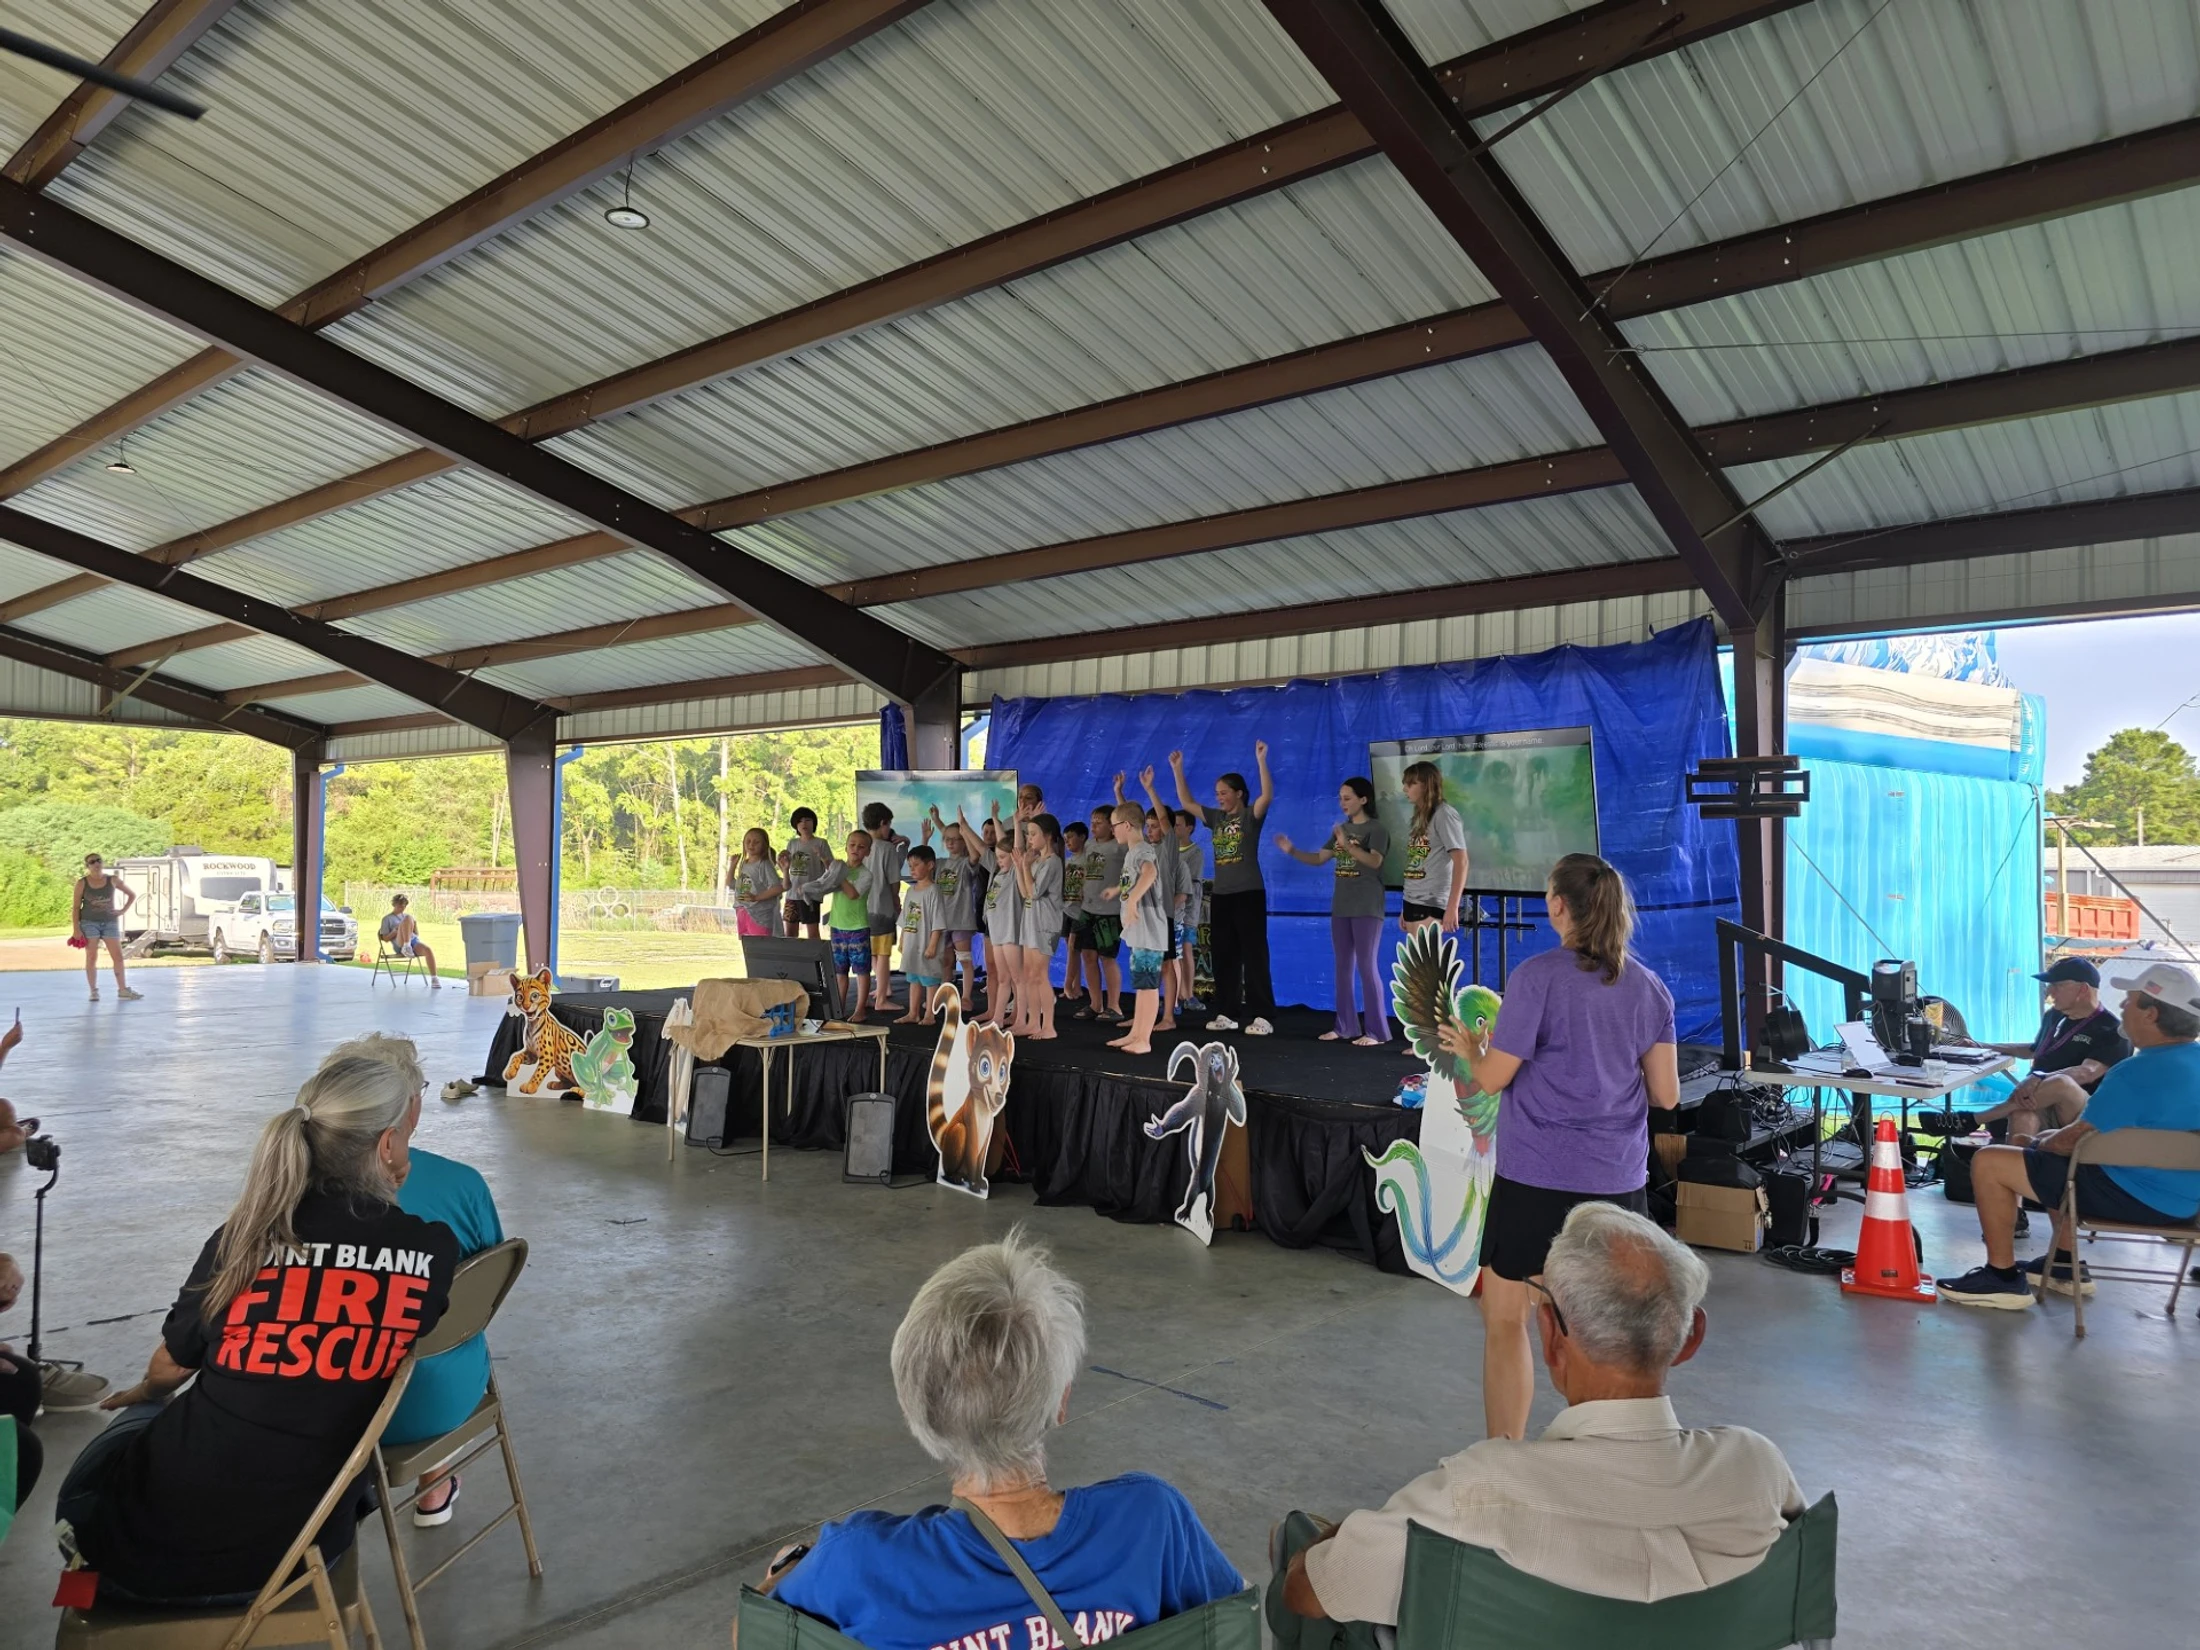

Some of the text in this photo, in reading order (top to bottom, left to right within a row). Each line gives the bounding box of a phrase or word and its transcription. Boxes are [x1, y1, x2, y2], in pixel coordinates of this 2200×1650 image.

[203, 862, 256, 870] ROCKWOOD
[335, 1244, 434, 1279] BLANK
[226, 1268, 430, 1331] FIRE
[216, 1322, 417, 1382] RESCUE
